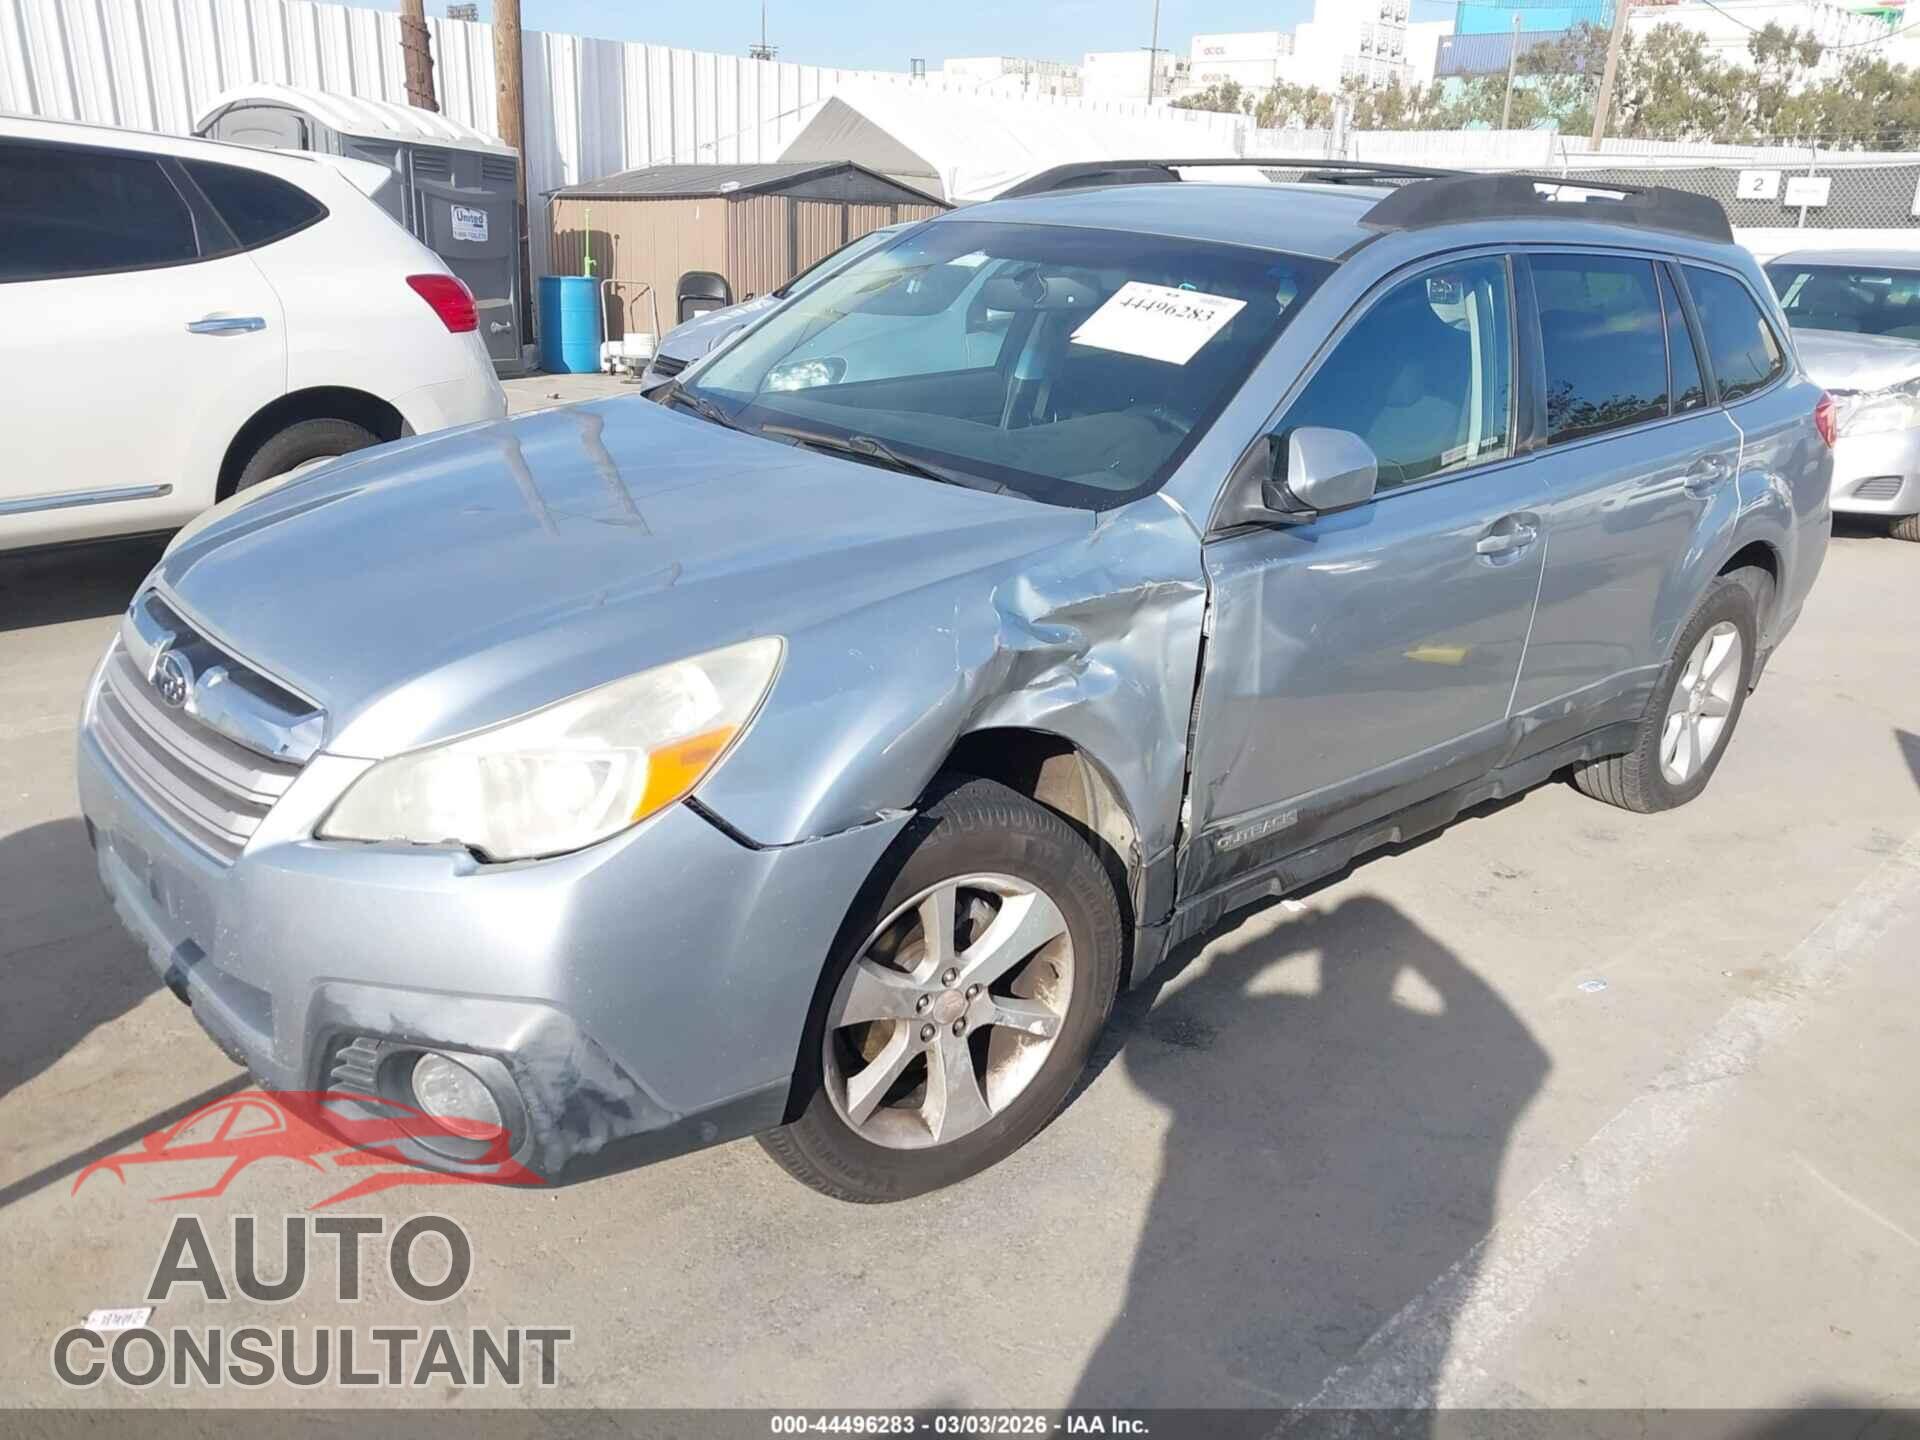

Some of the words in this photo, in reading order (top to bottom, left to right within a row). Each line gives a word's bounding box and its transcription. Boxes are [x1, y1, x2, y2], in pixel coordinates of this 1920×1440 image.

[1753, 177, 1764, 192] 2
[456, 210, 484, 224] United
[1119, 297, 1216, 322] 44496283
